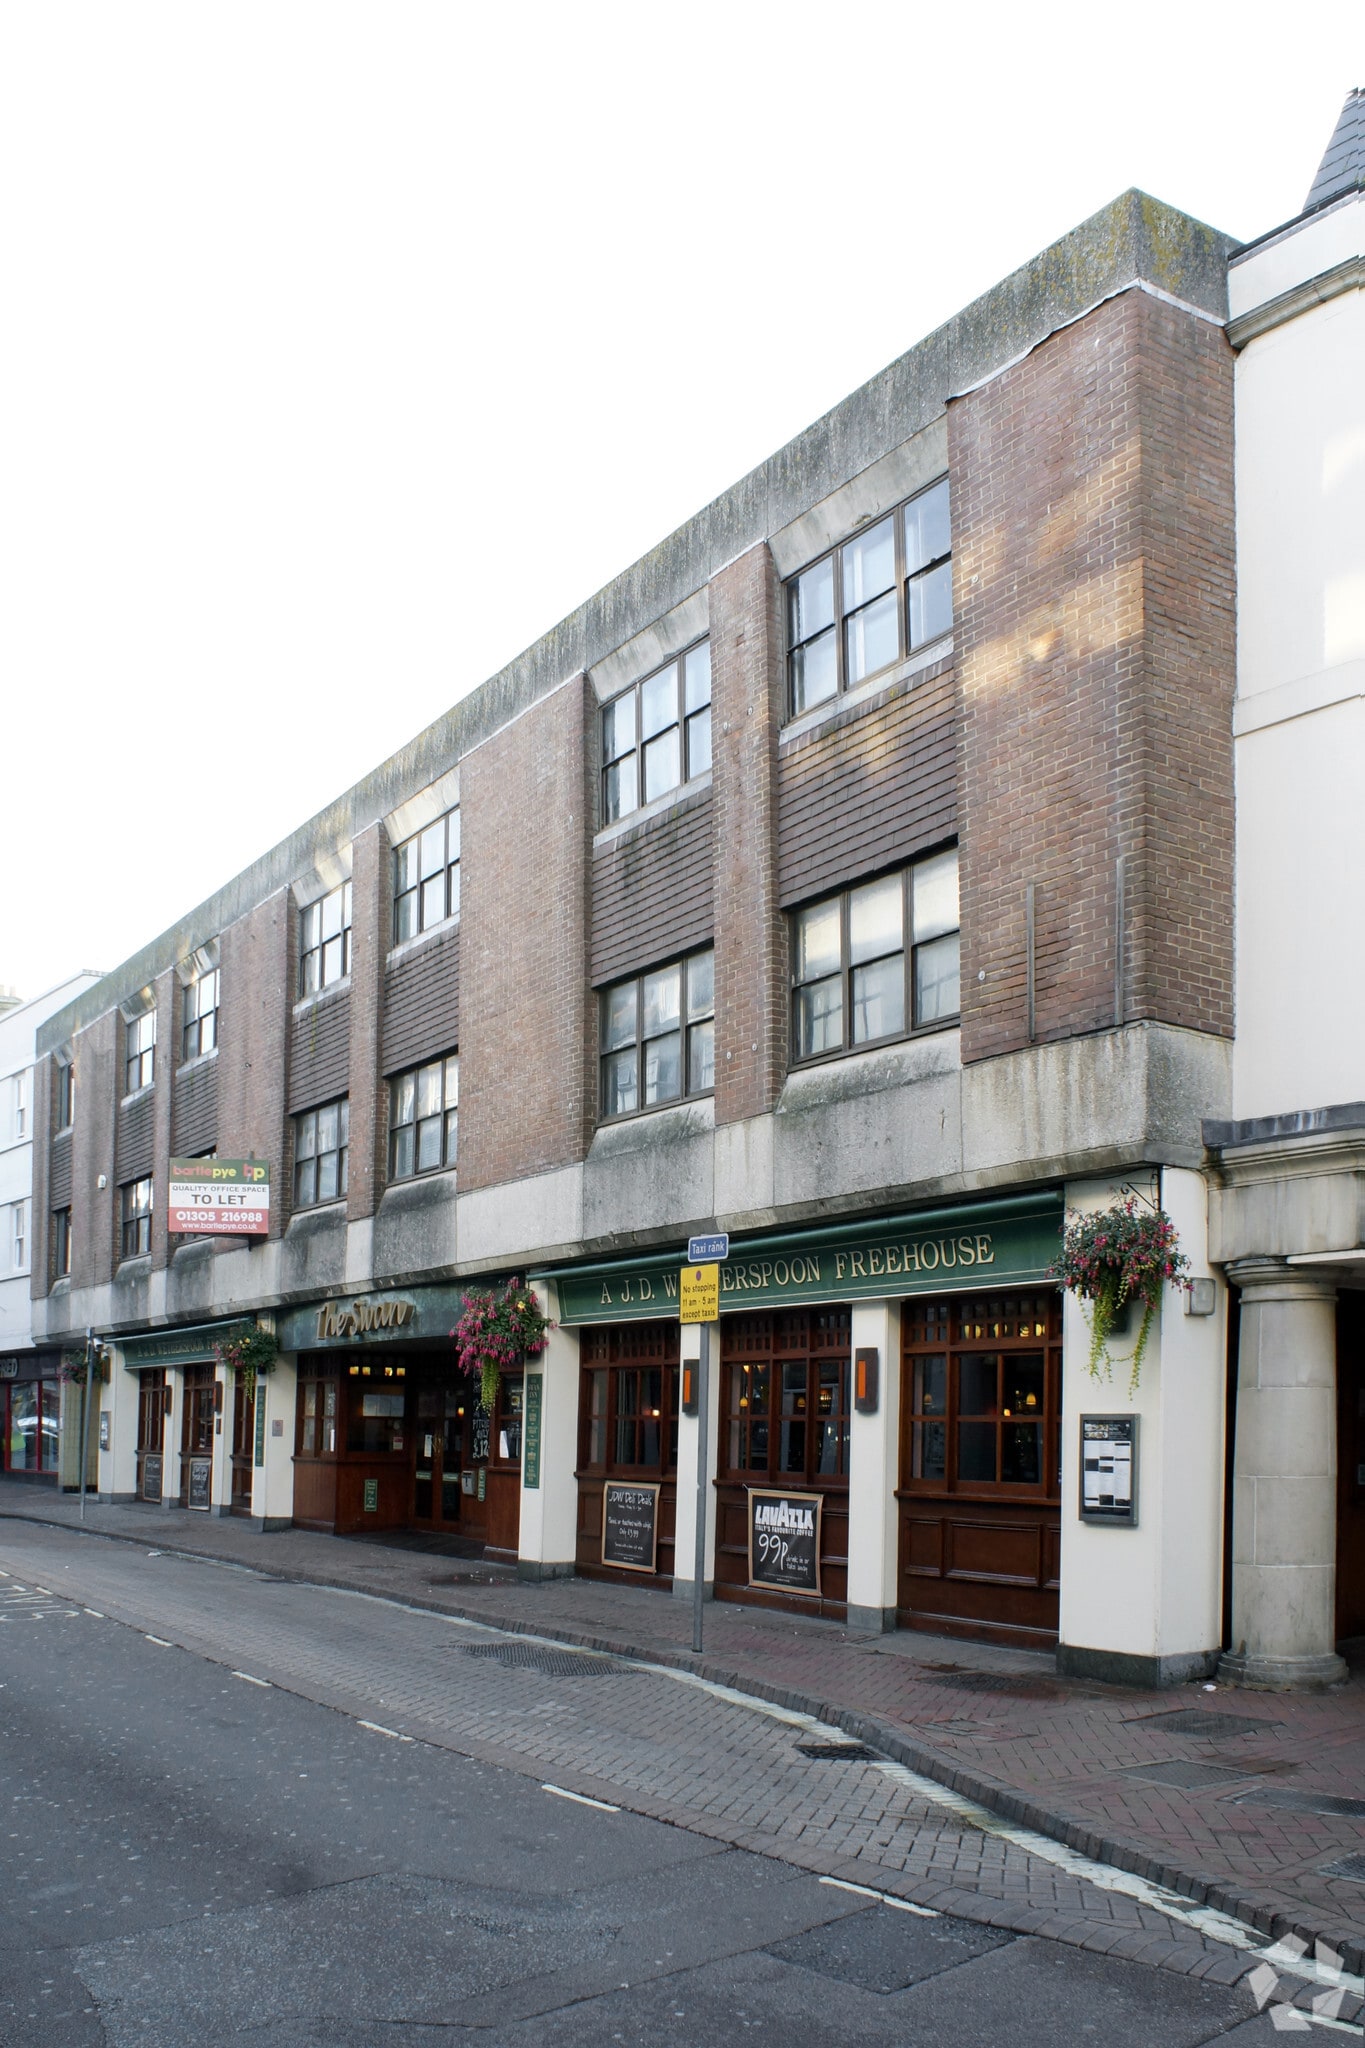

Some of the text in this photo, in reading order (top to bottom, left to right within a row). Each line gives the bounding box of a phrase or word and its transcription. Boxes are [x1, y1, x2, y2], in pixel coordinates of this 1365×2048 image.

[172, 1163, 266, 1181] bartlepye bp
[210, 1185, 240, 1193] OFFICE
[191, 1194, 247, 1205] TO LET
[176, 1211, 263, 1222] 01305 216988
[181, 1222, 258, 1230] www.bartlepye.co.uk
[692, 1241, 725, 1255] Taxi rank
[600, 1234, 995, 1304] A J.D. WERSPOON FREEHOUSE
[683, 1283, 716, 1294] No stopping
[702, 1296, 706, 1305] 5
[707, 1297, 716, 1305] am
[682, 1307, 716, 1319] except taxis
[316, 1300, 411, 1340] The Swan
[609, 1490, 625, 1503] JDW
[638, 1493, 653, 1506] Deals
[755, 1500, 814, 1530] LAVAZZA
[755, 1524, 814, 1537] ITALY'S FAVOURITE COFFEE
[758, 1533, 789, 1571] 99p
